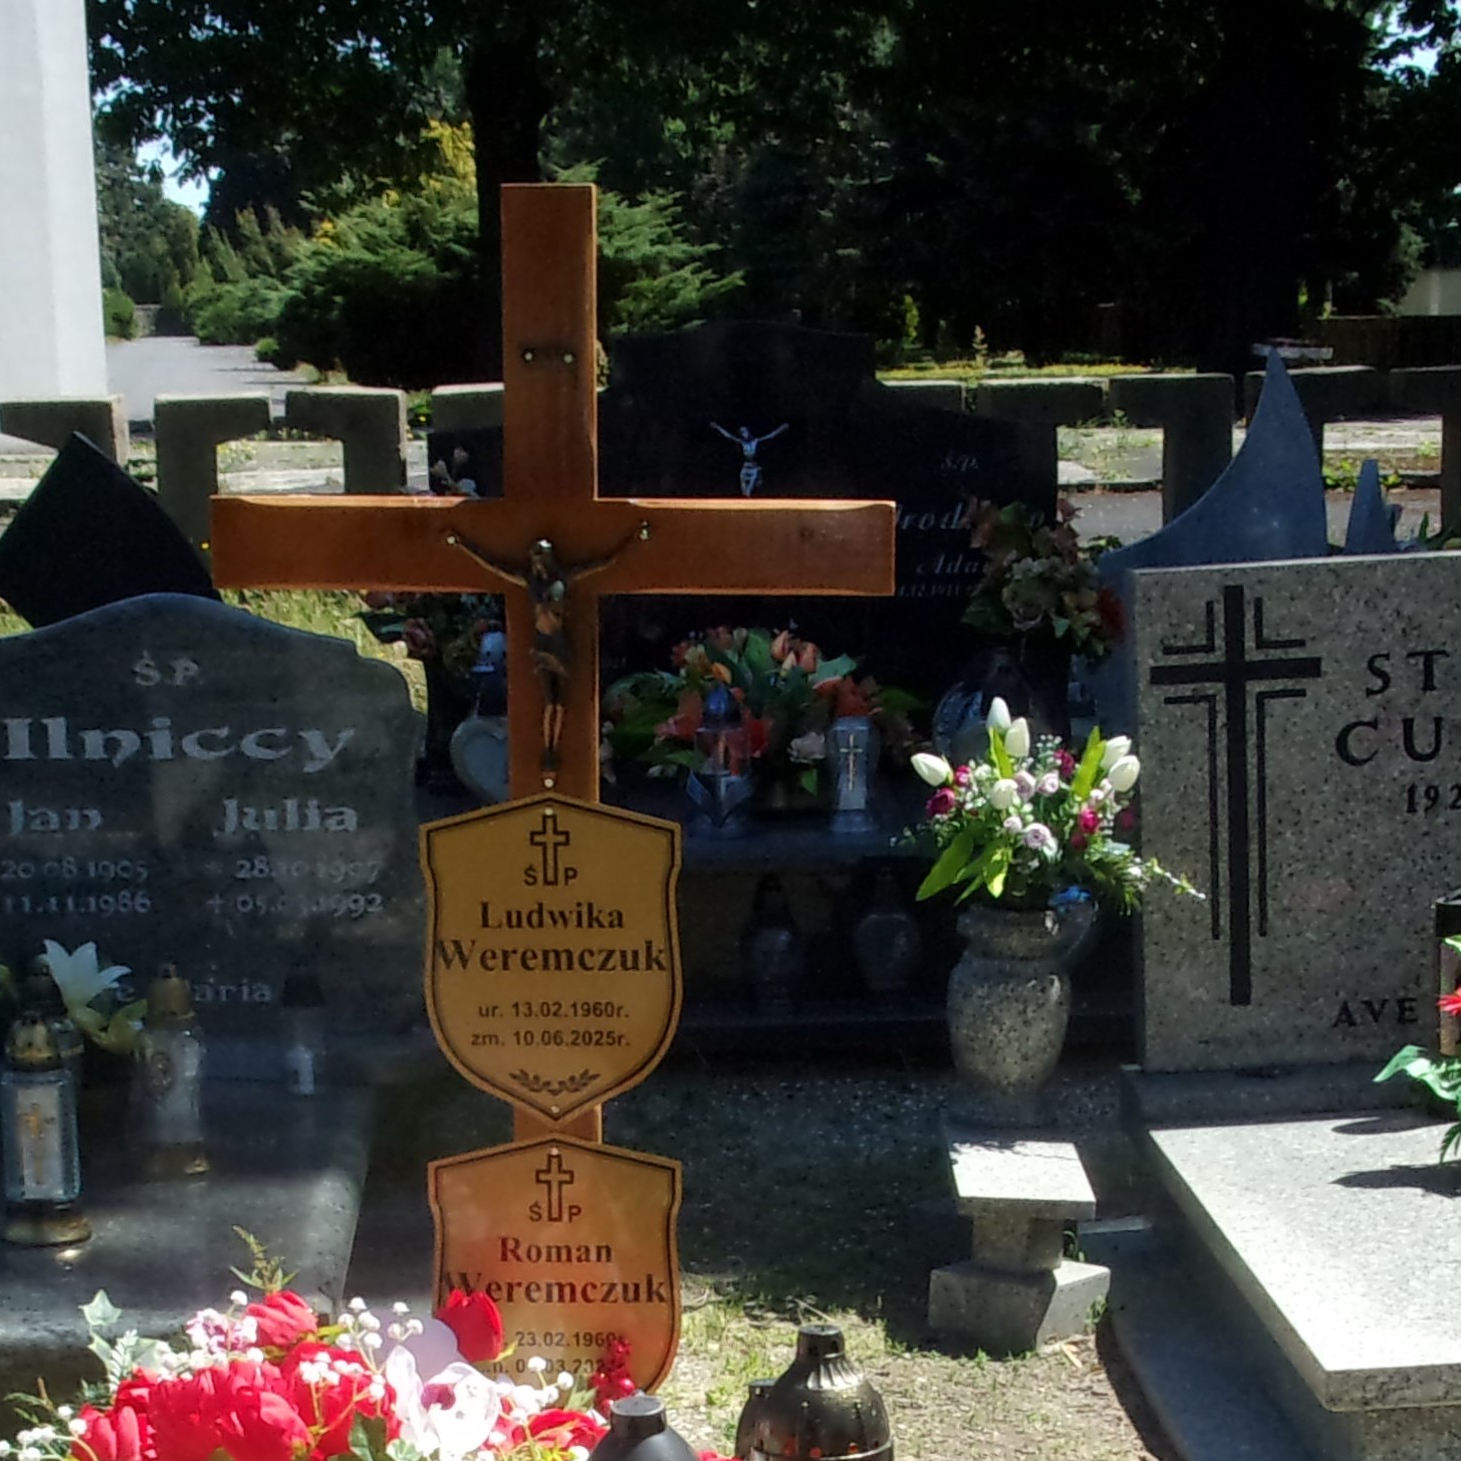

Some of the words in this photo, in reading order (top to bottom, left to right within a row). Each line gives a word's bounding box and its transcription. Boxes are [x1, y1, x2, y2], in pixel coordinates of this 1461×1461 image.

[2, 714, 355, 774] Ilniccy
[7, 799, 105, 836] Jan
[213, 797, 359, 838] Julia
[523, 862, 538, 886] Ś
[562, 867, 579, 887] P
[480, 900, 625, 930] Ludwika
[439, 939, 668, 973] Weremczuk
[194, 978, 273, 1003] aria
[479, 1004, 505, 1019] ur.
[512, 1000, 631, 1019] 13.02.1960r.
[1333, 997, 1420, 1029] AVE
[470, 1032, 507, 1048] zm.
[512, 1029, 632, 1048] 10.06.2025r.
[528, 1200, 543, 1223] Ś
[567, 1204, 582, 1223] P
[498, 1236, 613, 1264] Roman
